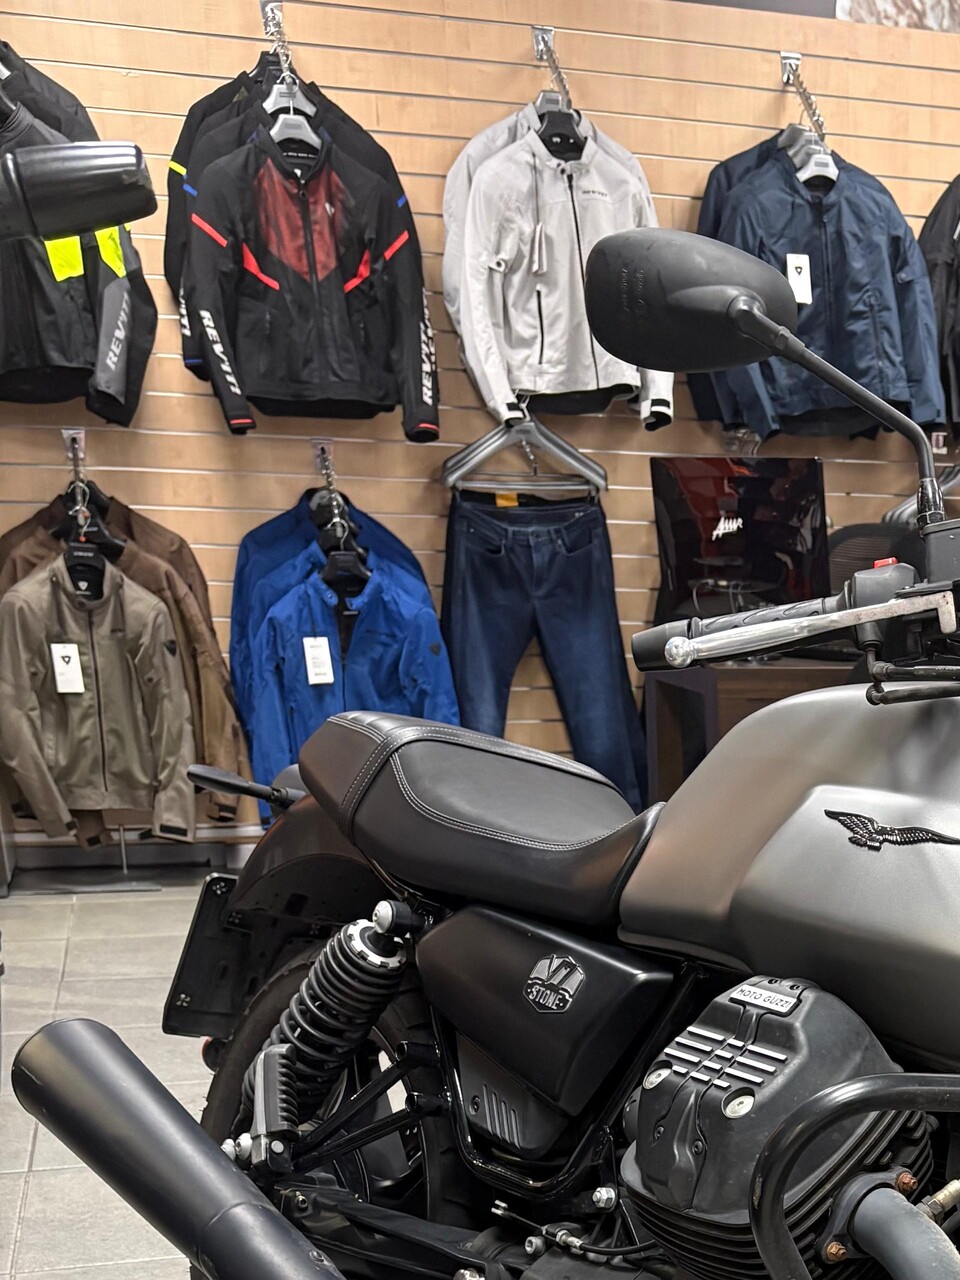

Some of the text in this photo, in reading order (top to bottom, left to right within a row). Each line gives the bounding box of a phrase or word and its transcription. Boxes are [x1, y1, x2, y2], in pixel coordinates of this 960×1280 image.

[529, 985, 563, 1010] STONE
[736, 988, 793, 1008] MOTO GUZZI
